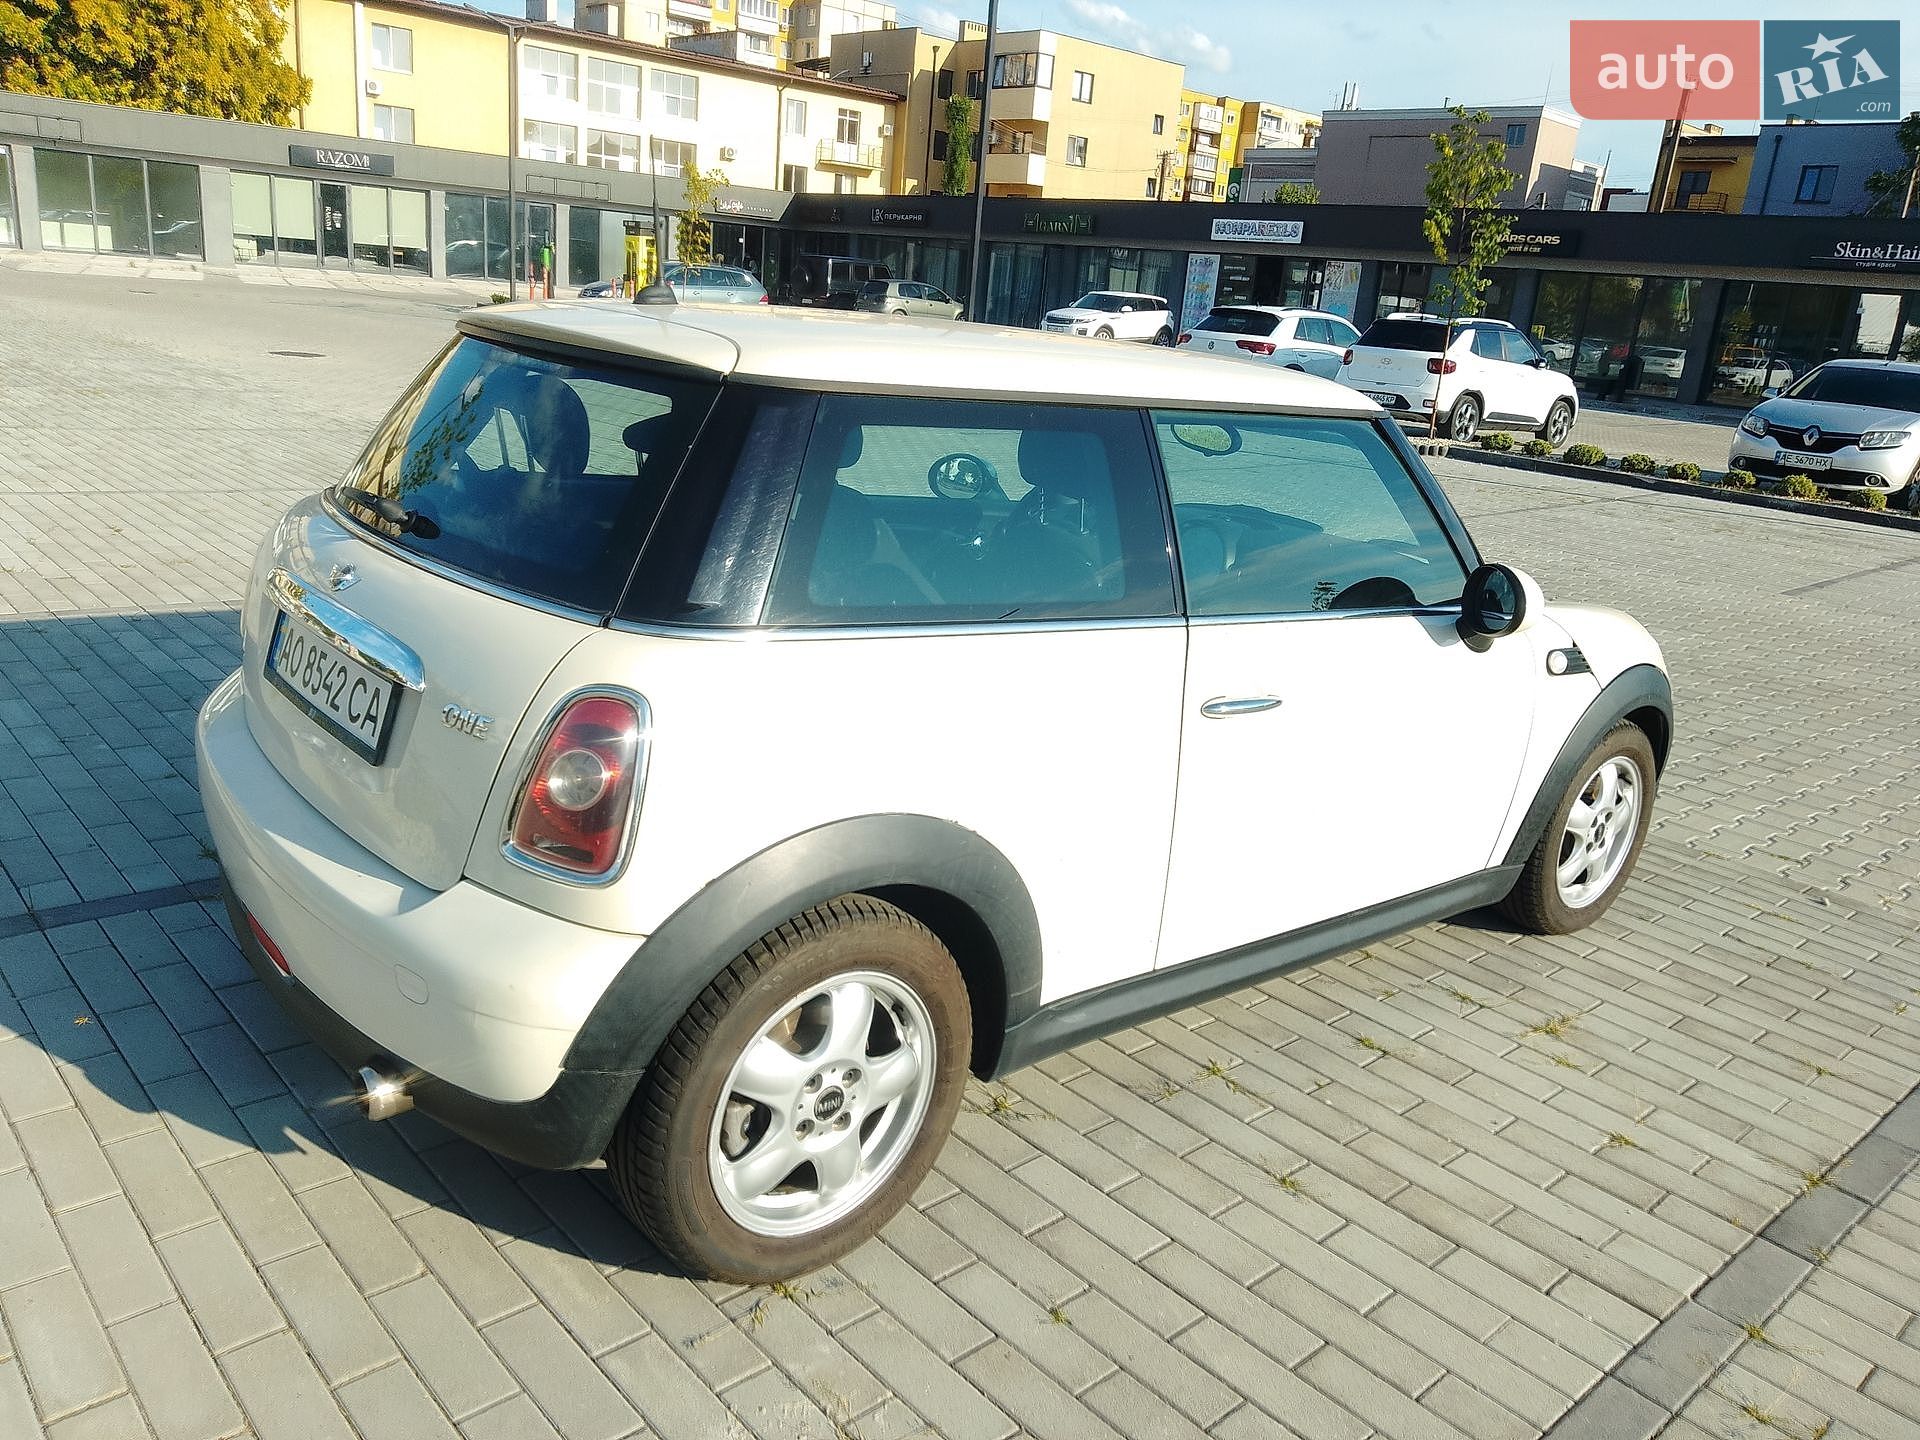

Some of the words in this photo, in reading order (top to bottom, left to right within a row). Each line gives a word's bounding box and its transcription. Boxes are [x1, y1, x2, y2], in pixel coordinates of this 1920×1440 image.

[884, 213, 923, 221] ПЕРУКАРНЯ
[1527, 235, 1560, 245] CARS
[1780, 453, 1792, 463] AE
[1795, 455, 1814, 466] 5670
[1815, 457, 1829, 468] HX
[280, 629, 303, 677] AO
[303, 646, 347, 712] 8542
[349, 677, 381, 738] CA
[442, 702, 495, 740] ONE
[817, 1096, 841, 1114] MINI
